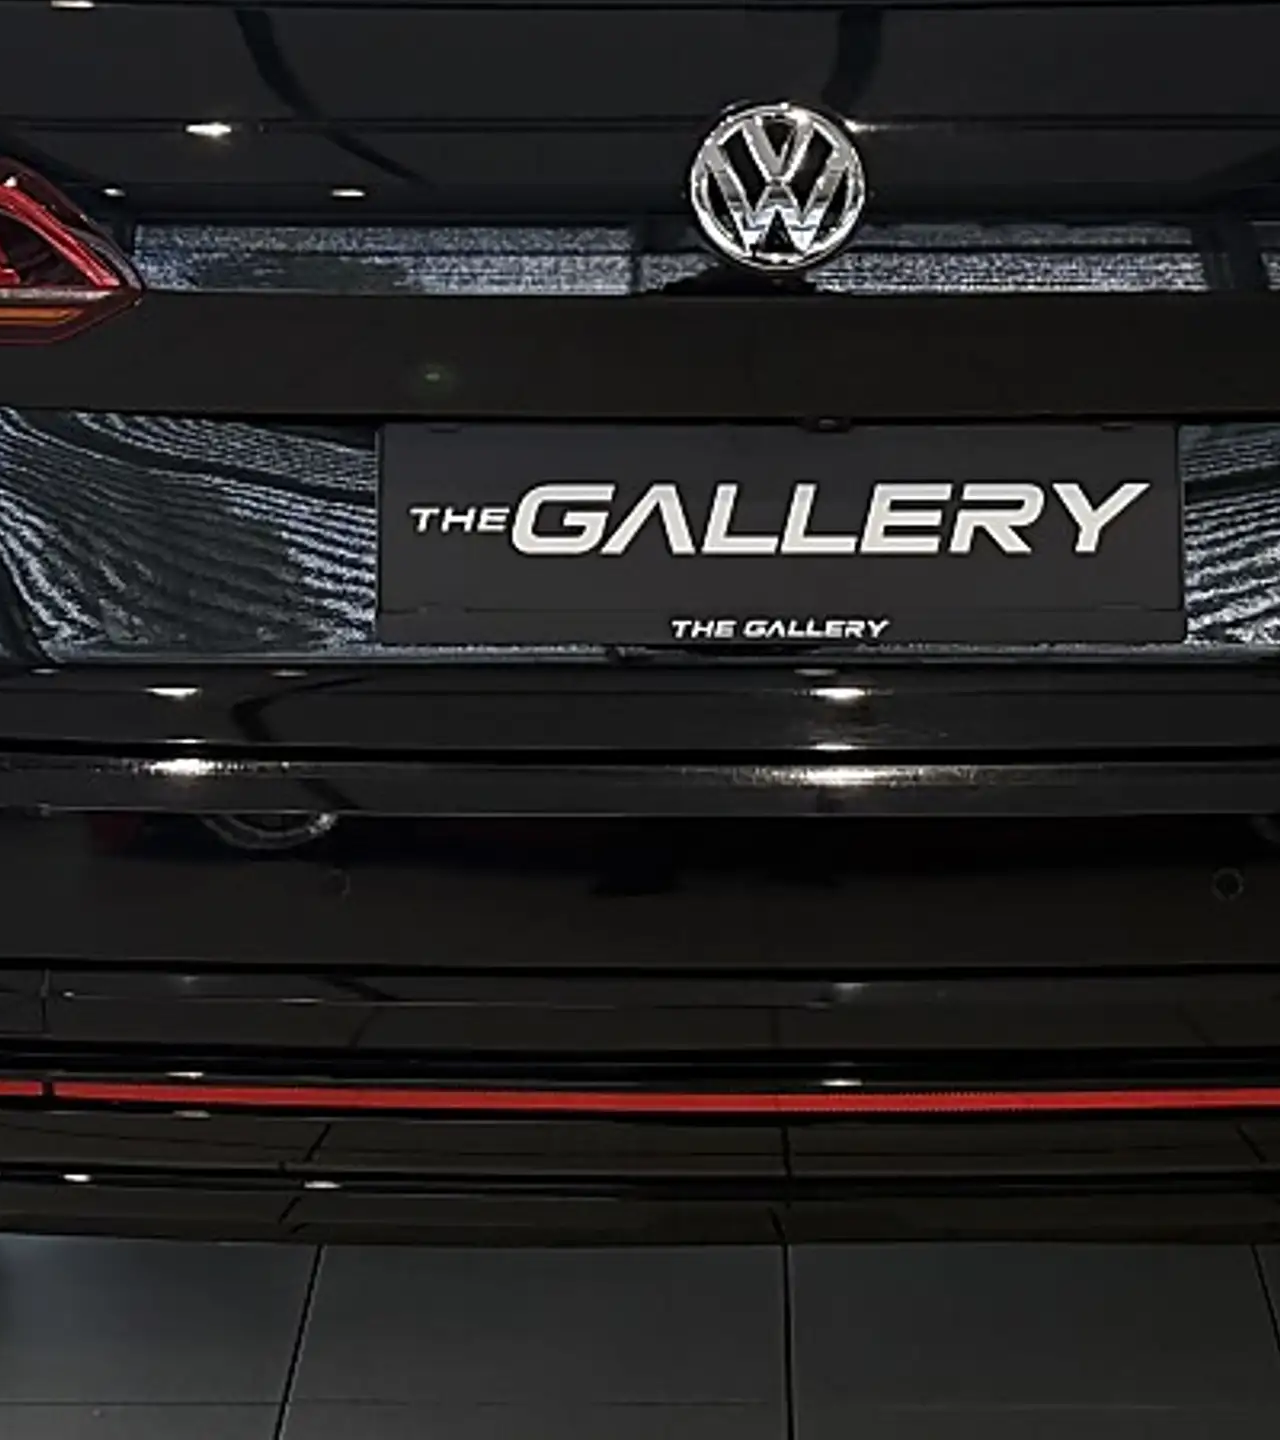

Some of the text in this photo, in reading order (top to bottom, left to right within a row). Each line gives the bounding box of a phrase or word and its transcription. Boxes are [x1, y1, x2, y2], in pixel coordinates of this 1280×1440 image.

[408, 482, 1151, 555] THE GALLERY
[670, 618, 892, 640] THE GALLERY
